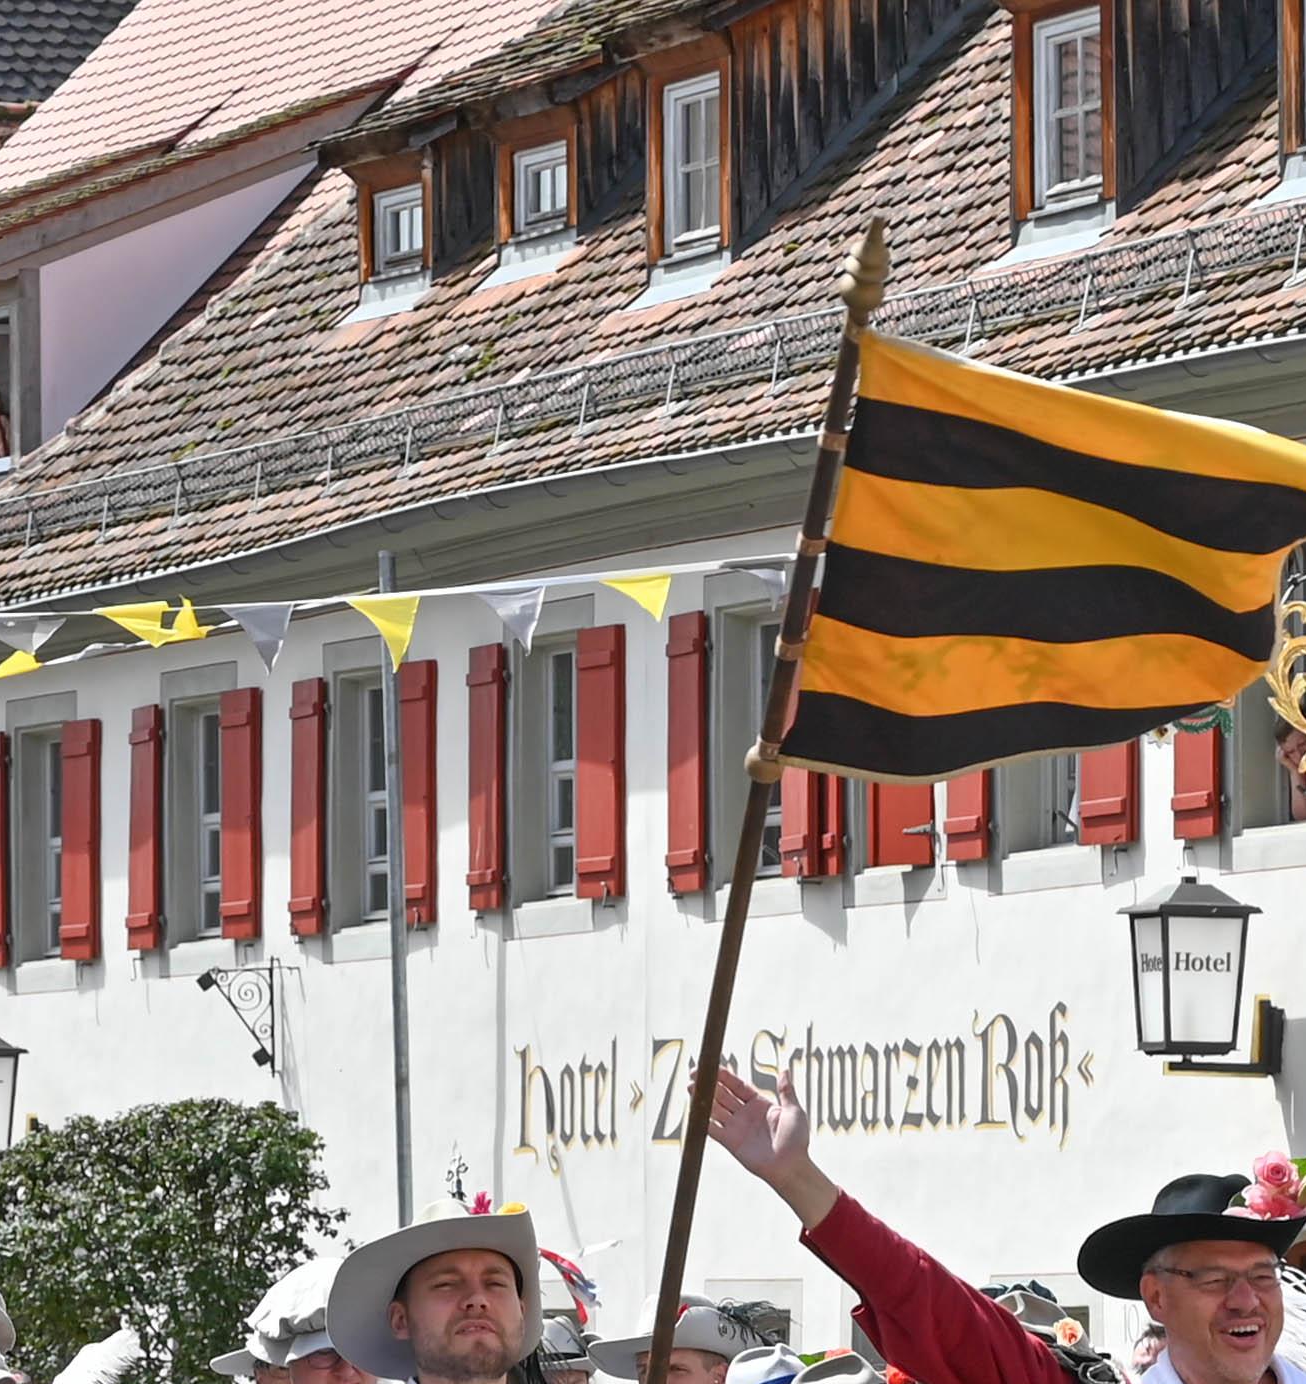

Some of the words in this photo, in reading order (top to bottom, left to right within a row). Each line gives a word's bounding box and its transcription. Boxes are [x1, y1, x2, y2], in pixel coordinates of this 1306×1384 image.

[1140, 953, 1163, 973] Hote
[1174, 952, 1232, 972] Hotel
[513, 1034, 618, 1175] Hotel
